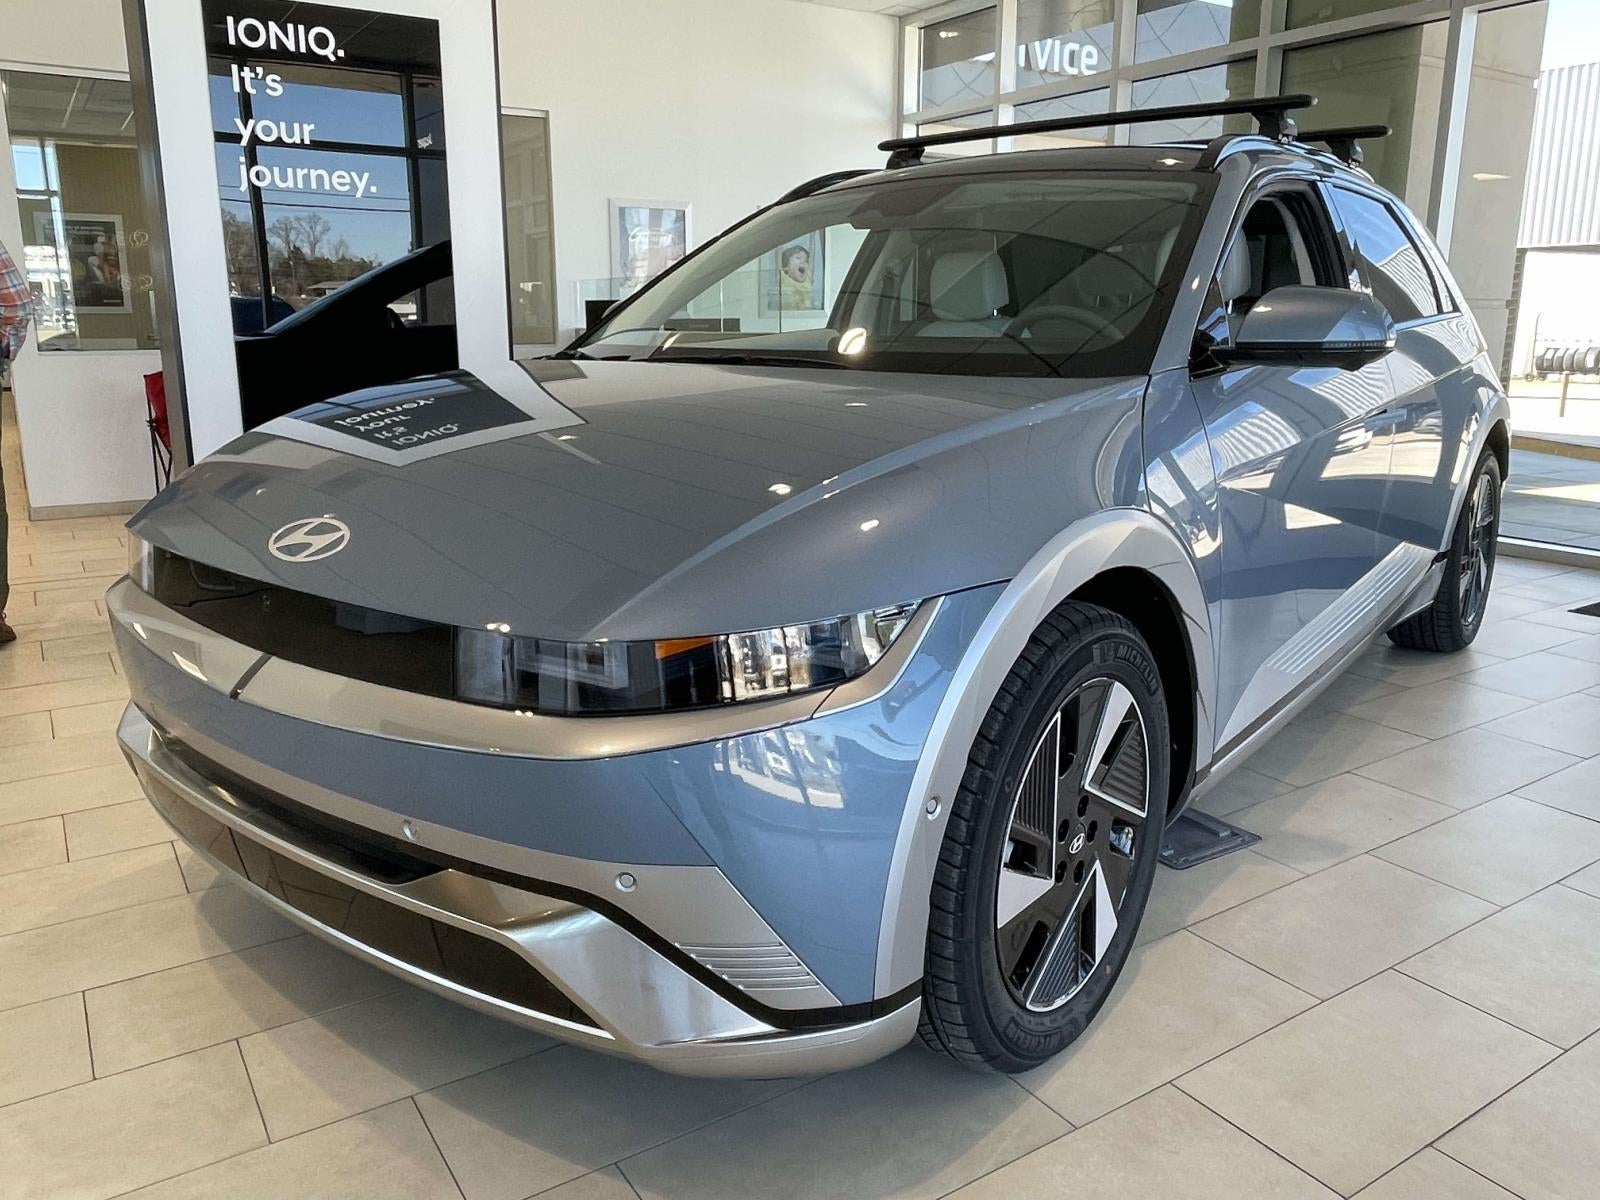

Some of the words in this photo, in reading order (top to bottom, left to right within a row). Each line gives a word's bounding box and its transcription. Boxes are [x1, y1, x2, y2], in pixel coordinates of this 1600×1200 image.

[226, 15, 345, 62] IONIQ.
[230, 63, 284, 97] It's
[234, 117, 316, 147] your
[238, 156, 378, 198] journey.
